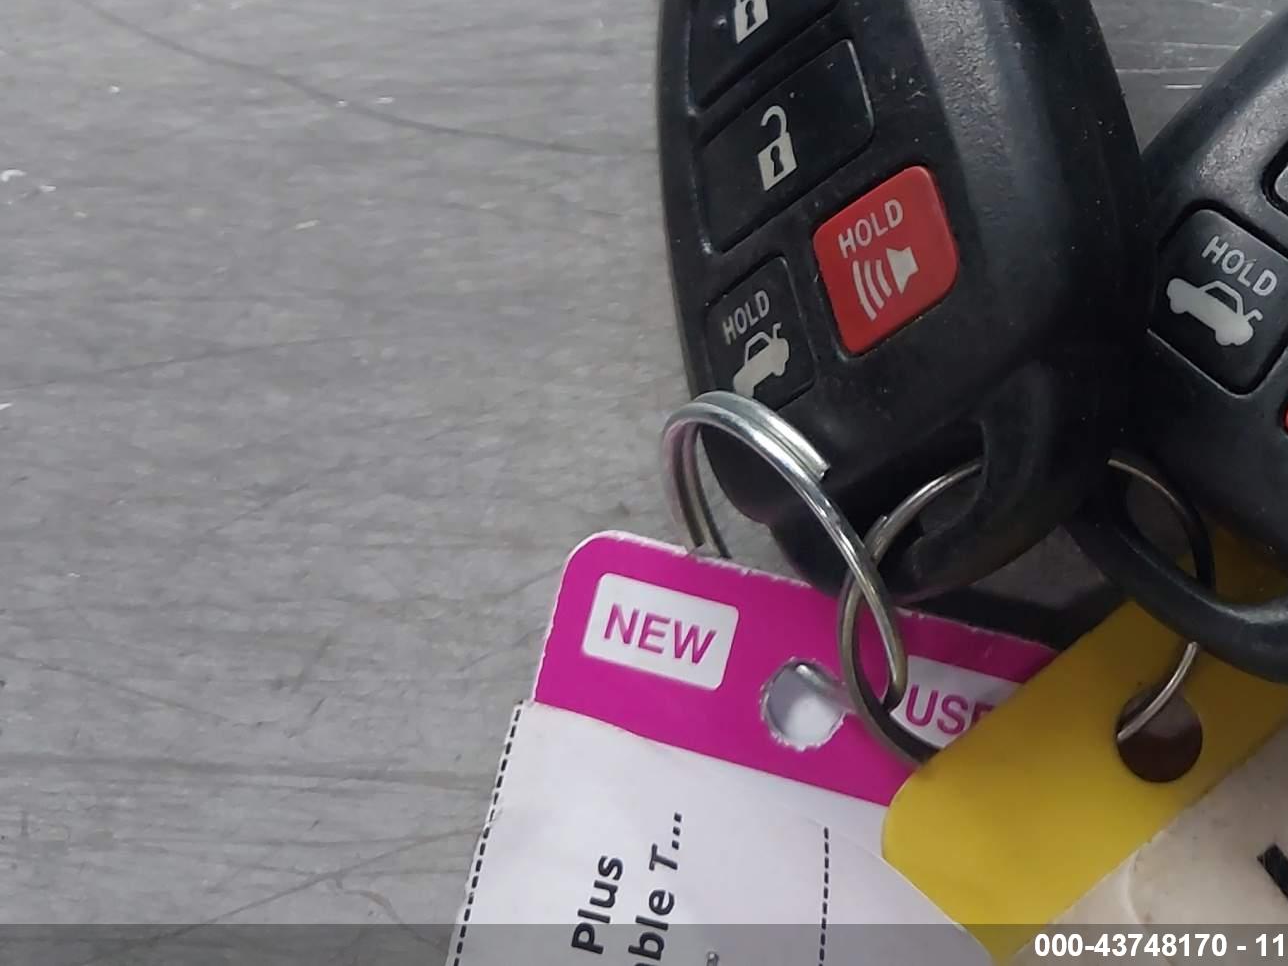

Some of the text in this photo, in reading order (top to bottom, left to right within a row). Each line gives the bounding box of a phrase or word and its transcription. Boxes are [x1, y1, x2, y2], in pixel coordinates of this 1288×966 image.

[837, 198, 904, 258] HOLD
[1201, 235, 1278, 298] HOLD
[721, 289, 771, 345] HOLD
[604, 603, 717, 664] NEW
[906, 684, 995, 735] US
[571, 855, 623, 955] Plus
[628, 888, 675, 966] ble
